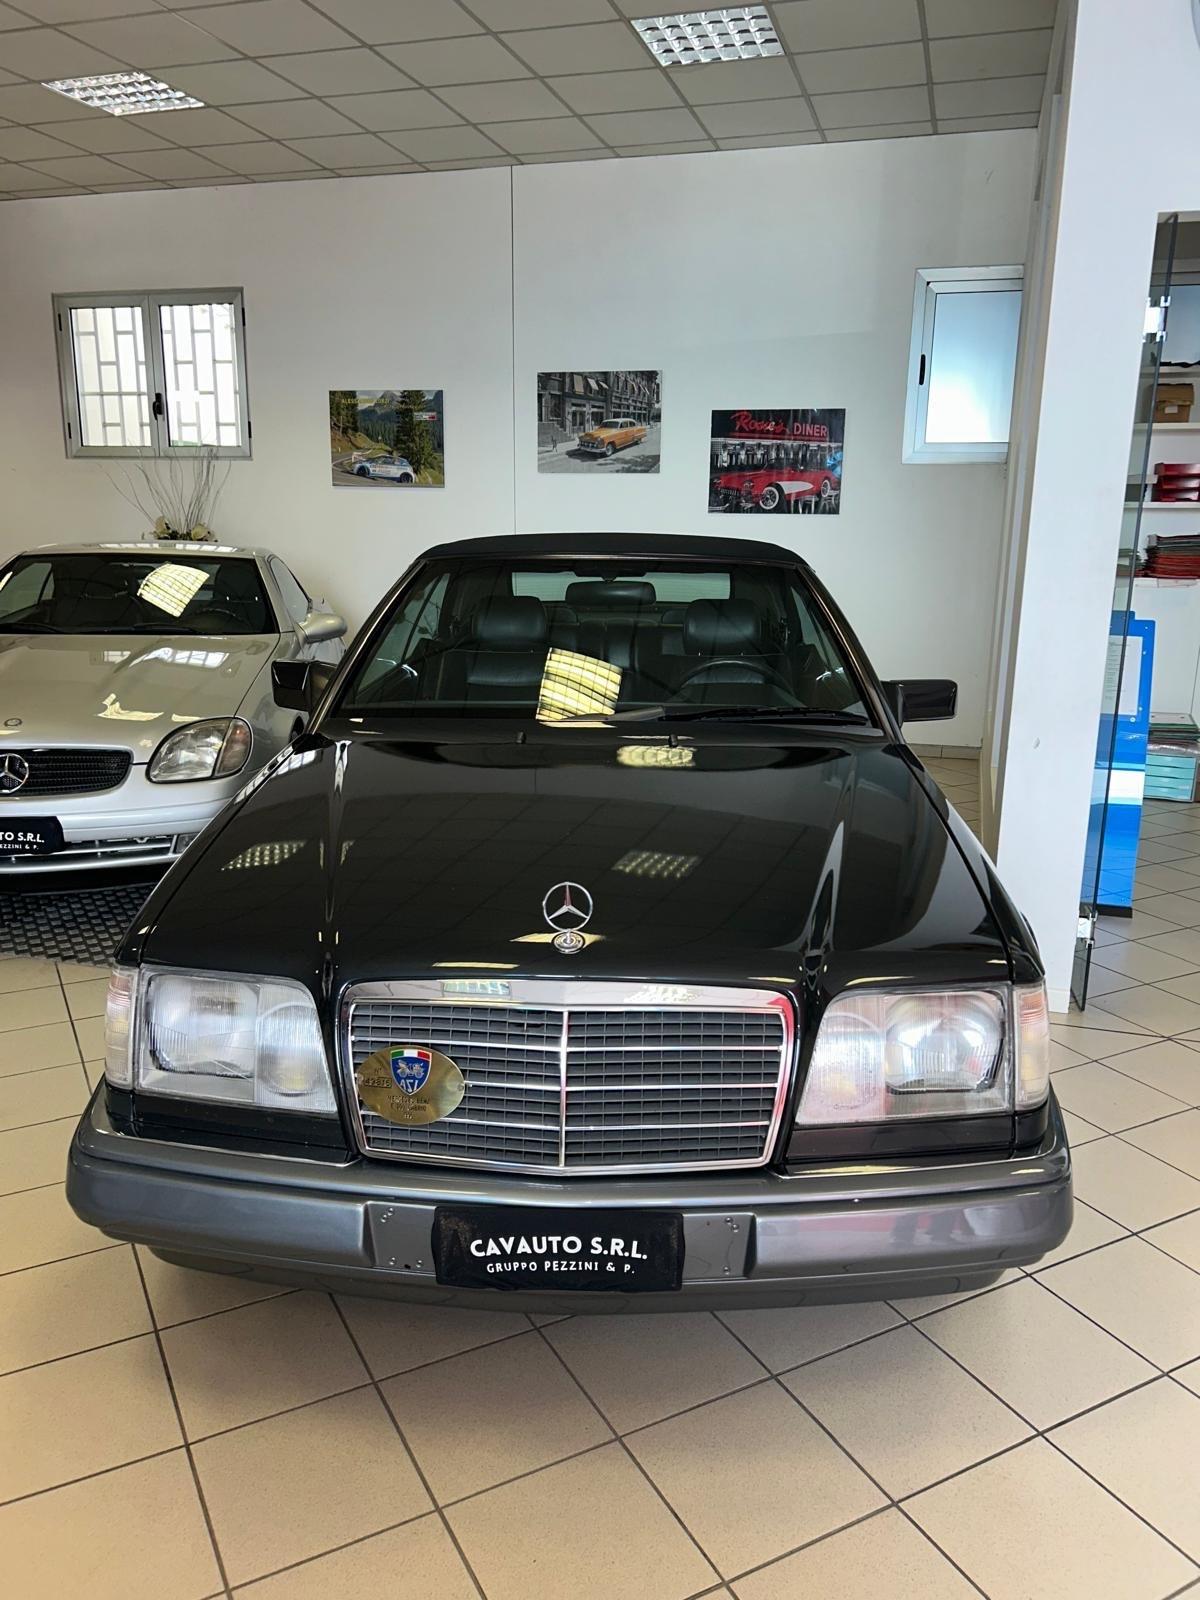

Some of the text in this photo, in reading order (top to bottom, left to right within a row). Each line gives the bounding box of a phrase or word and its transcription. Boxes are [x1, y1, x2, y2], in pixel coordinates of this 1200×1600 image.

[793, 422, 828, 437] DINER
[17, 832, 45, 843] S.R.L.
[470, 1236, 648, 1260] CAVAUTO S.R.L.
[486, 1260, 636, 1274] GRUPPO PEZZINI & P.
